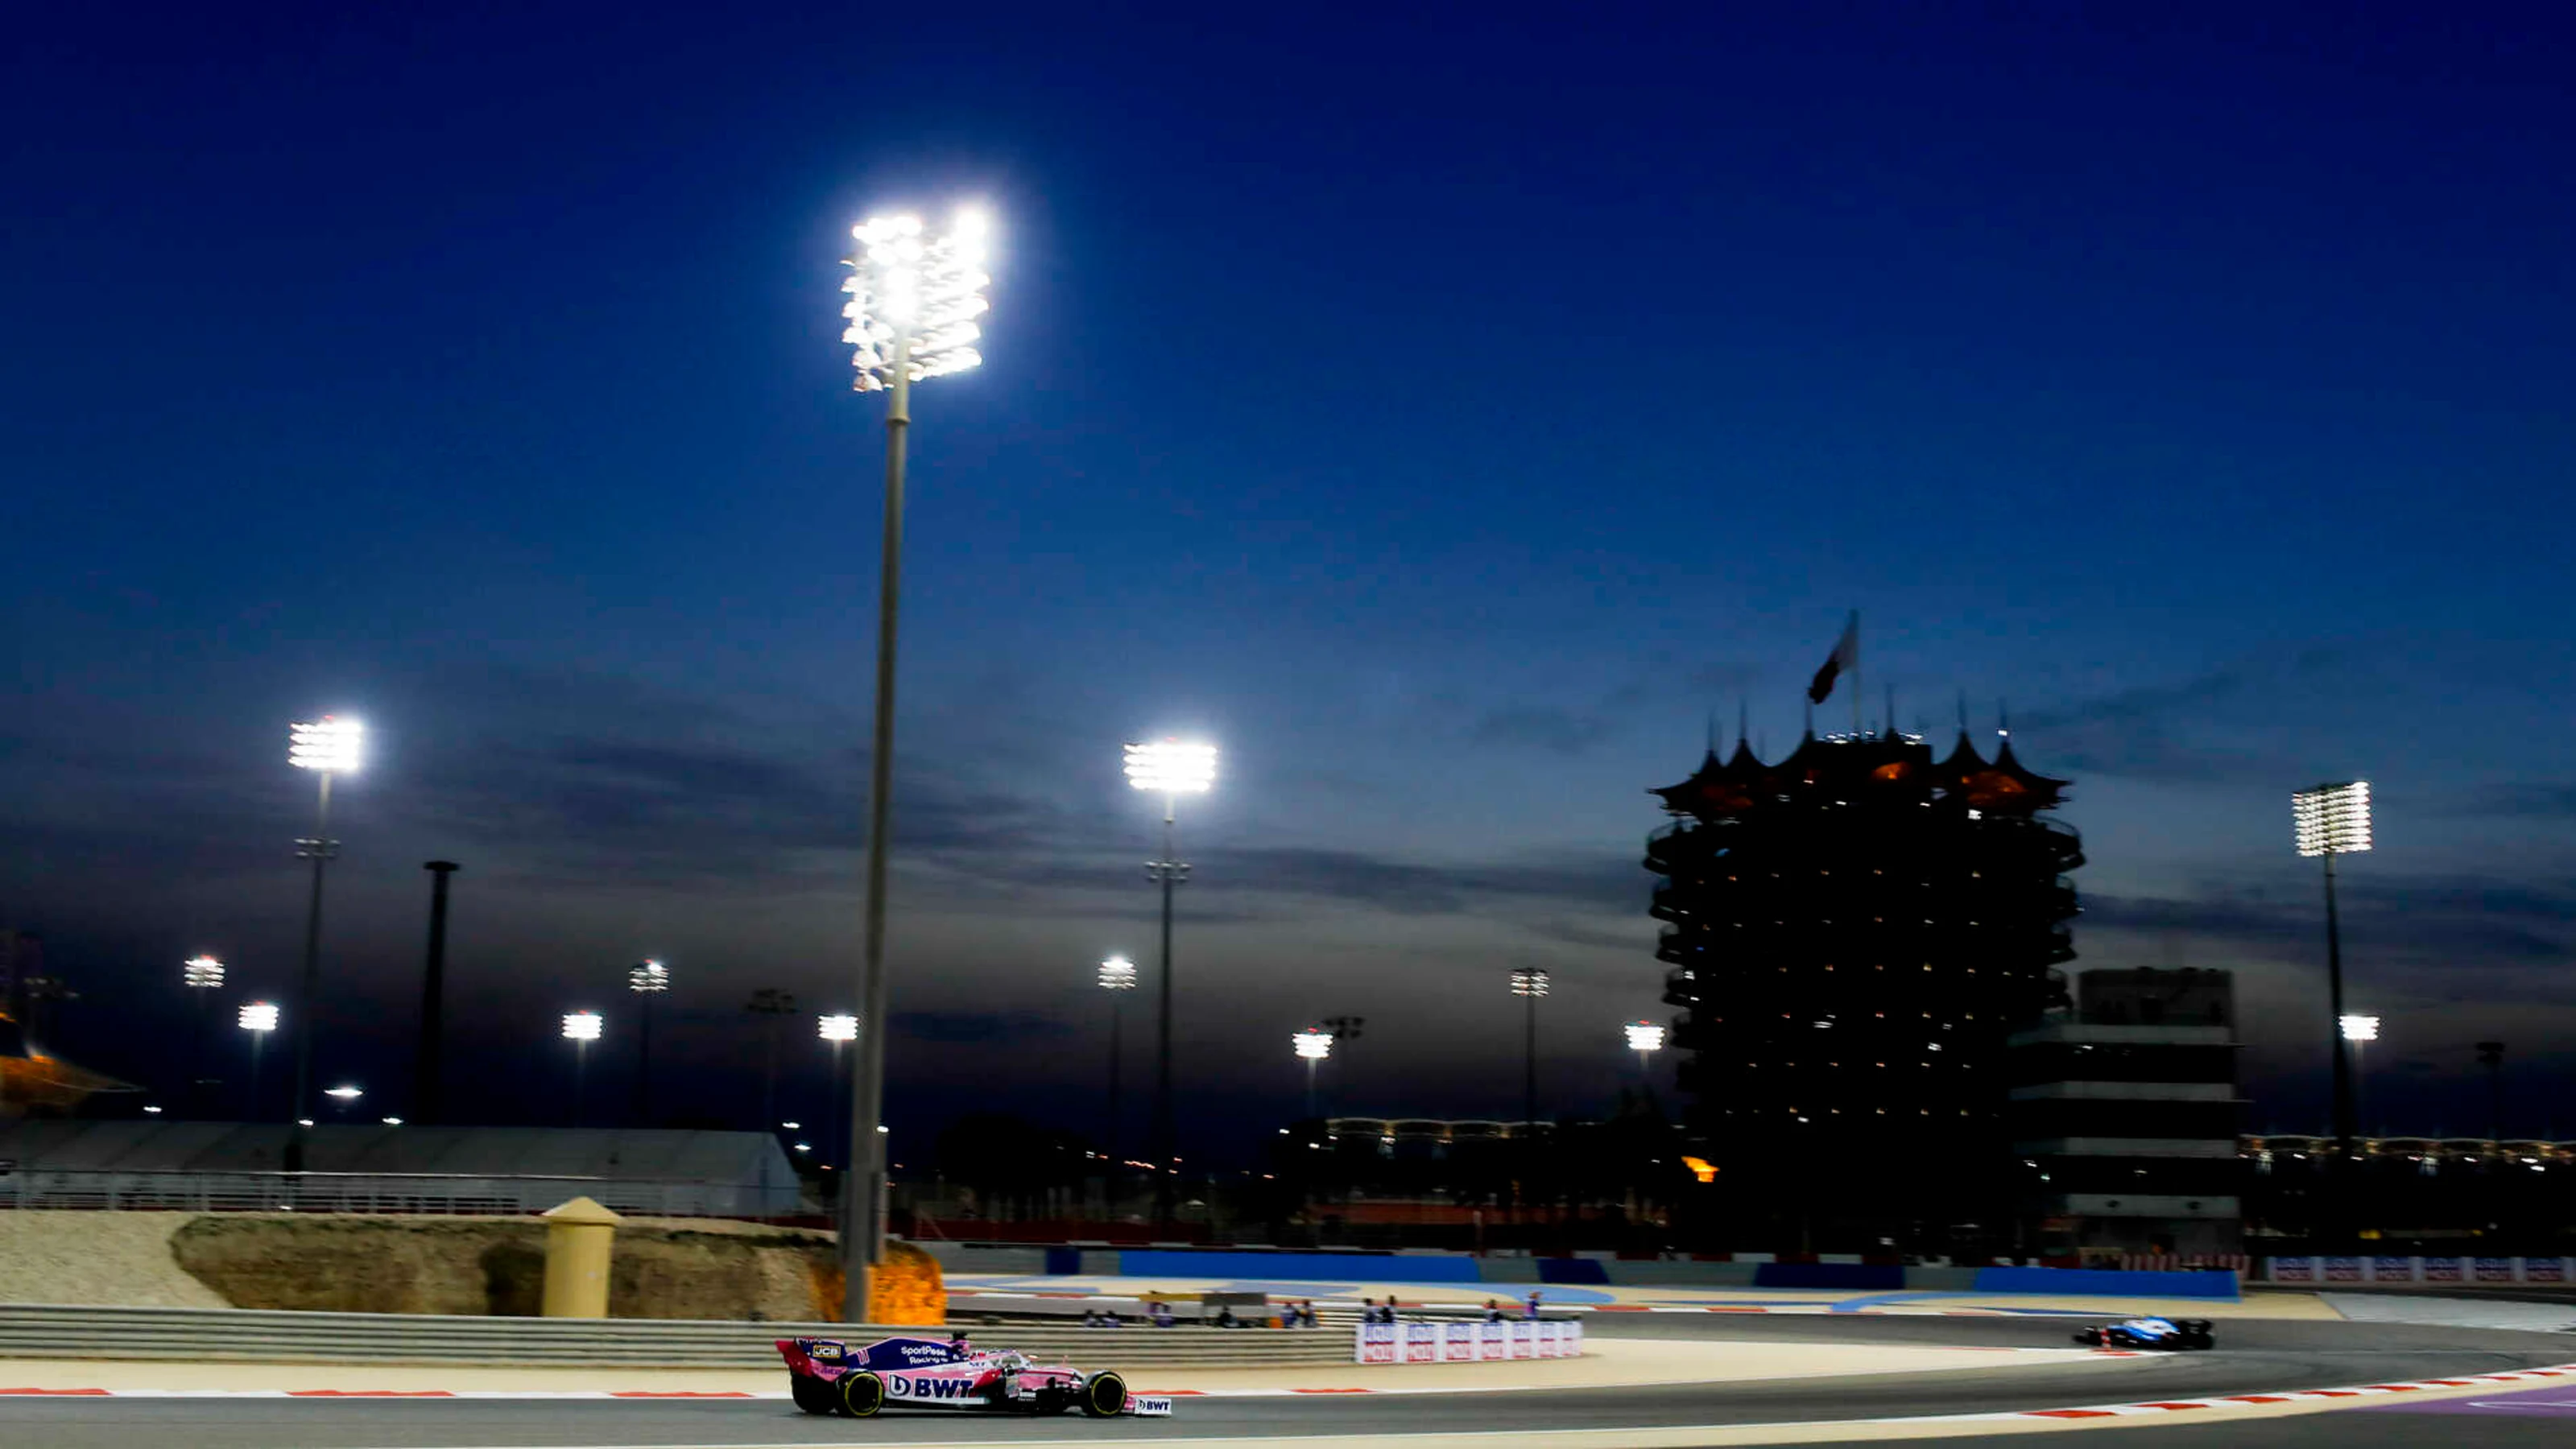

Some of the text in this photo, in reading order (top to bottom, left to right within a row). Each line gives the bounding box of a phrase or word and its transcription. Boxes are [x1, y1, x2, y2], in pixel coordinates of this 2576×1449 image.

[815, 1348, 838, 1356] JCB
[915, 1378, 973, 1398] BWT
[1147, 1401, 1169, 1410] BWT
